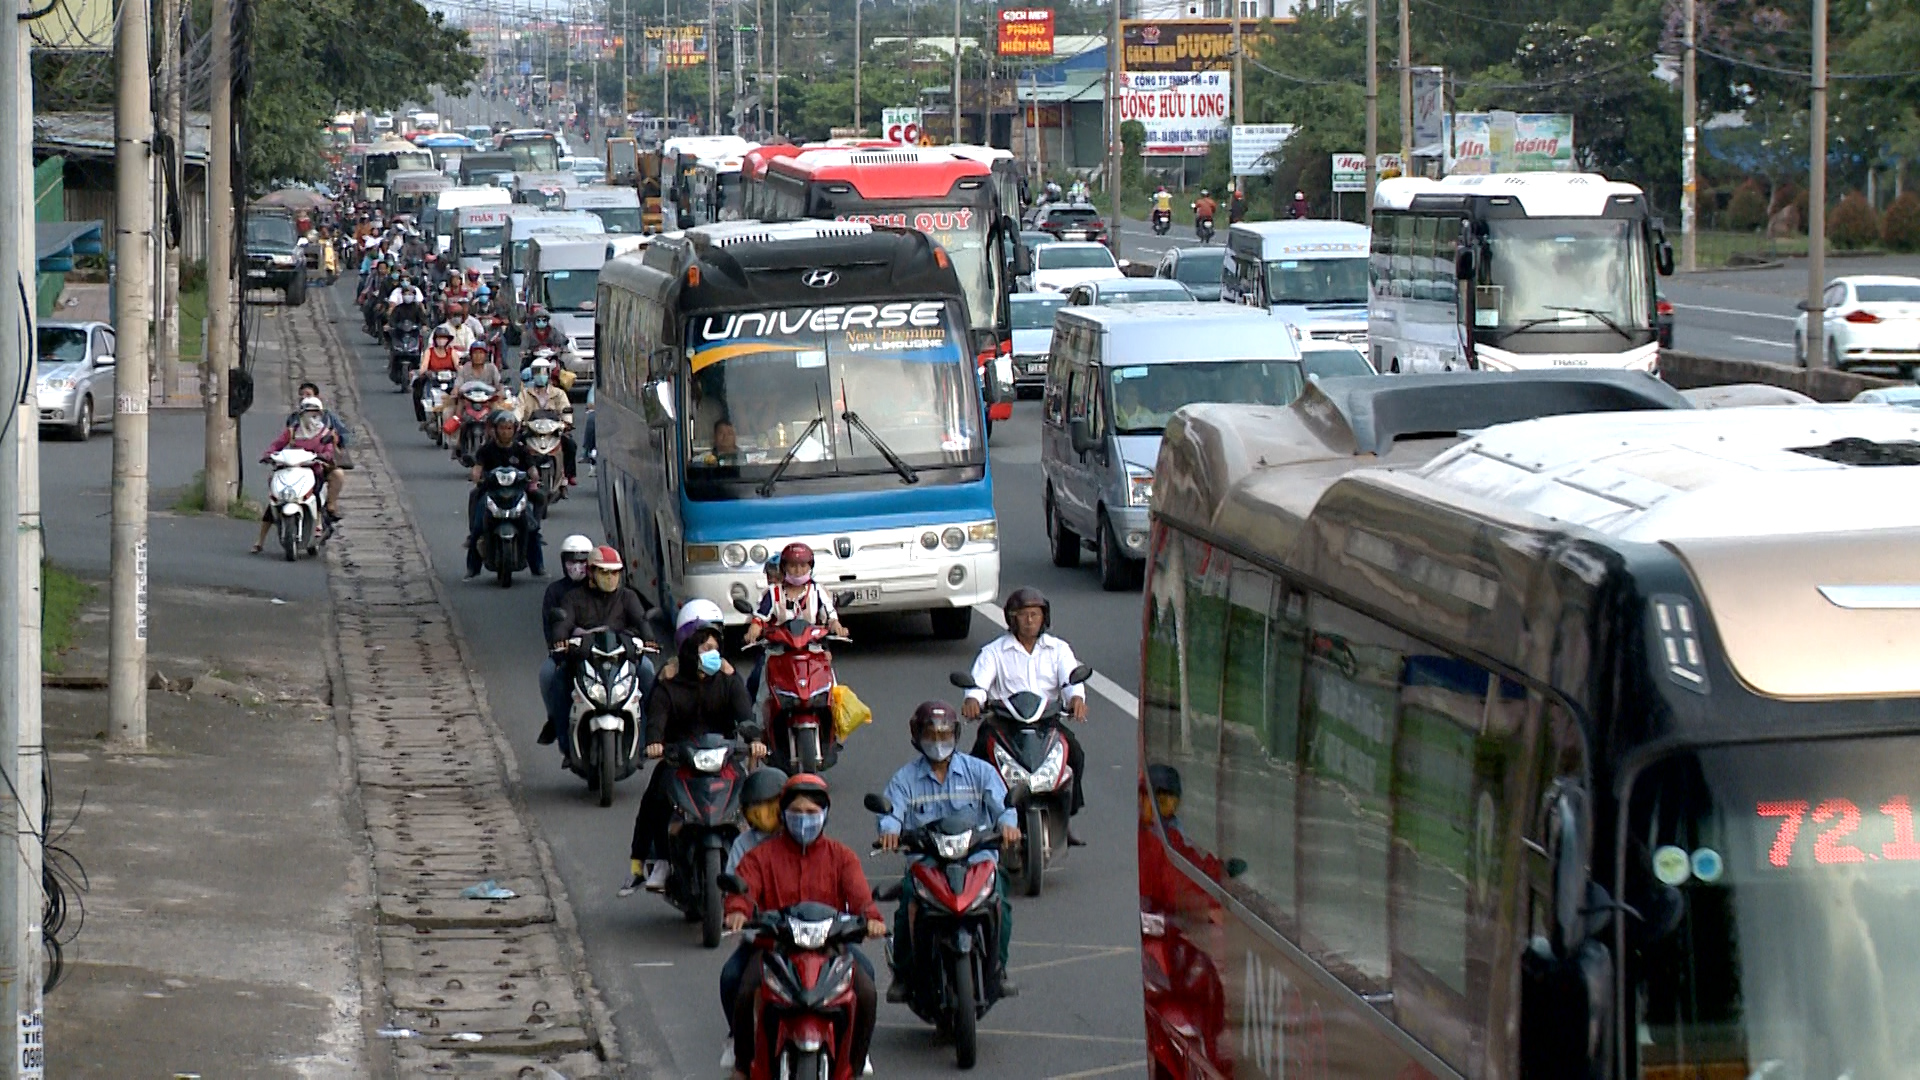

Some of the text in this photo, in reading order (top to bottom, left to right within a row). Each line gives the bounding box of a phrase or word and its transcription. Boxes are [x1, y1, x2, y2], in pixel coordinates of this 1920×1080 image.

[1120, 89, 1155, 118] ƯƠNG
[1190, 93, 1224, 118] LONG
[702, 302, 945, 341] UNIVERSE
[845, 326, 946, 343] New Premium
[848, 338, 944, 352] VIP LIMOUSINE
